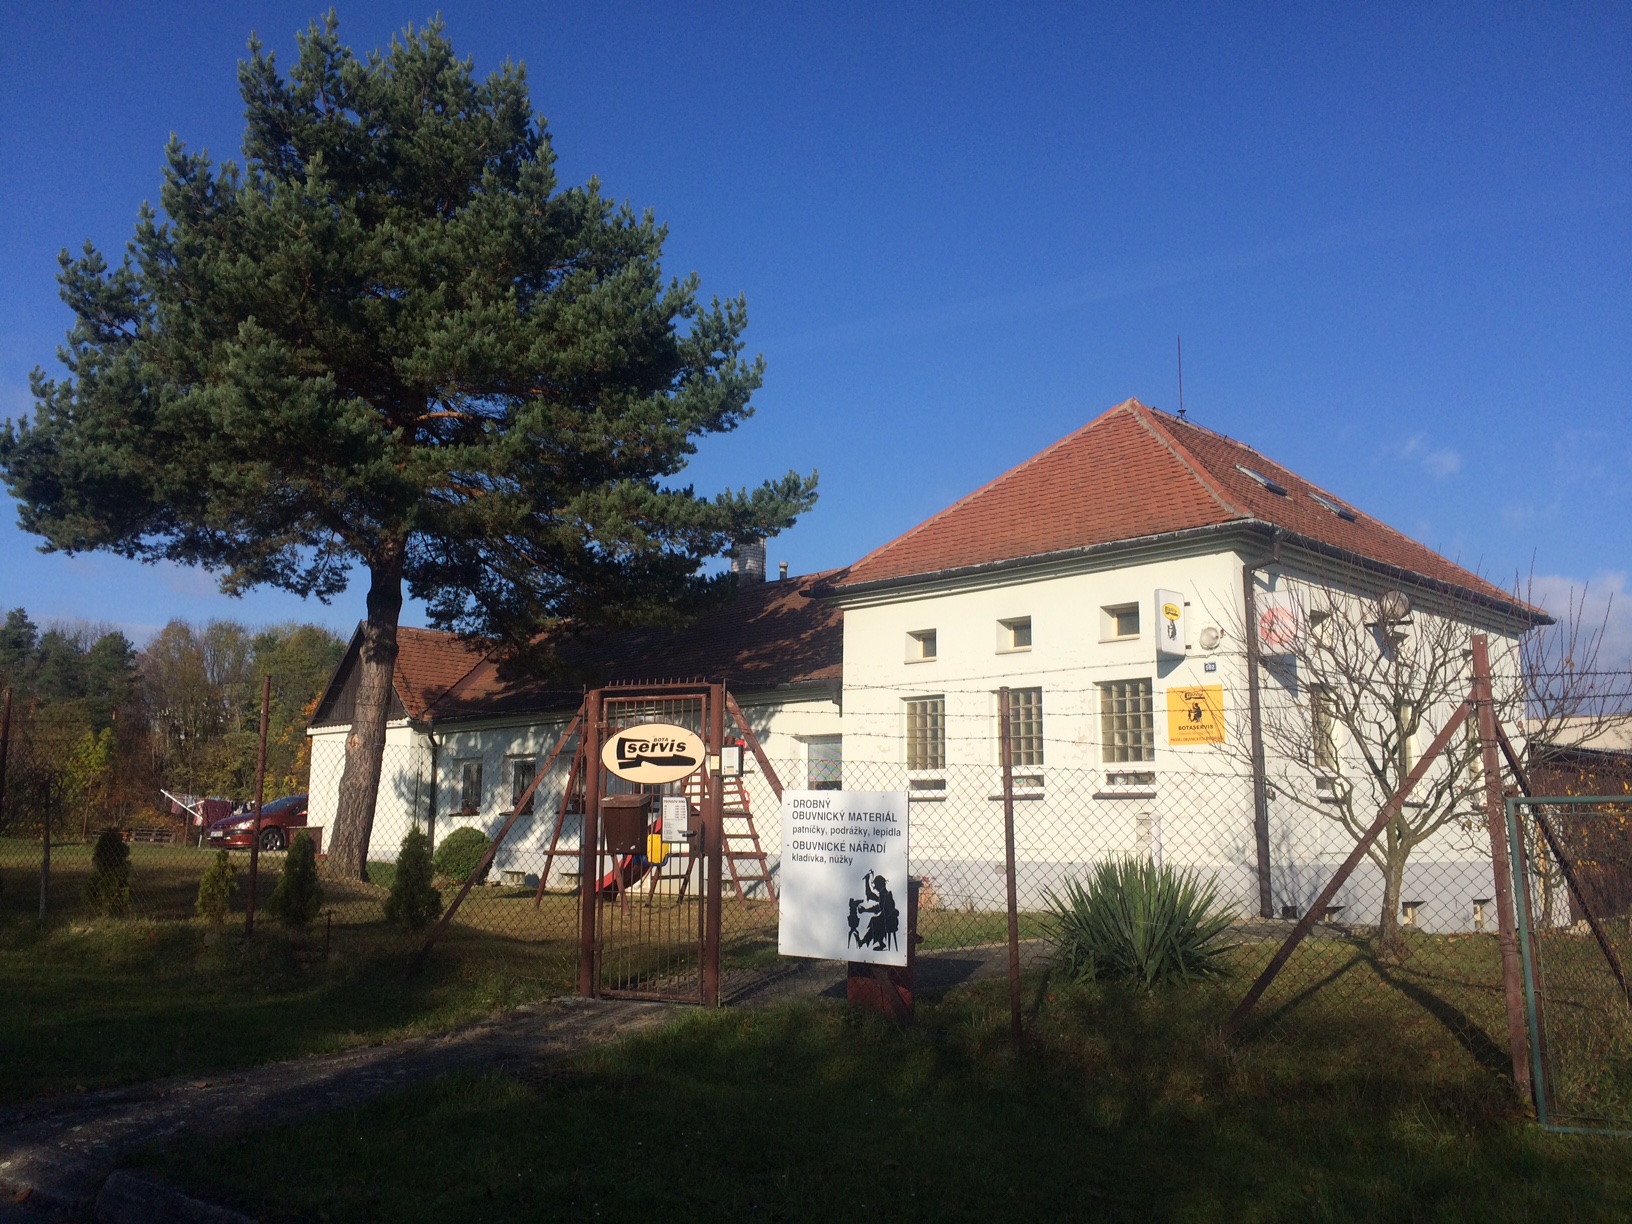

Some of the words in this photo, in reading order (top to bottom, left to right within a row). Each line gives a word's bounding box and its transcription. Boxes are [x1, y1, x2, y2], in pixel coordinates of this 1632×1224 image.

[627, 739, 687, 753] servis
[793, 798, 831, 808] DROBNÝ
[792, 810, 845, 821] OBUVNICKÝ
[848, 811, 898, 822] MATERIÁL
[792, 825, 828, 835] patníčky,
[830, 826, 871, 837] podrážky,
[873, 827, 901, 838] lepidla
[792, 840, 846, 852] OBUVNICKÉ
[849, 841, 887, 853] NÁŘADÍ
[792, 853, 827, 864] kladívka,
